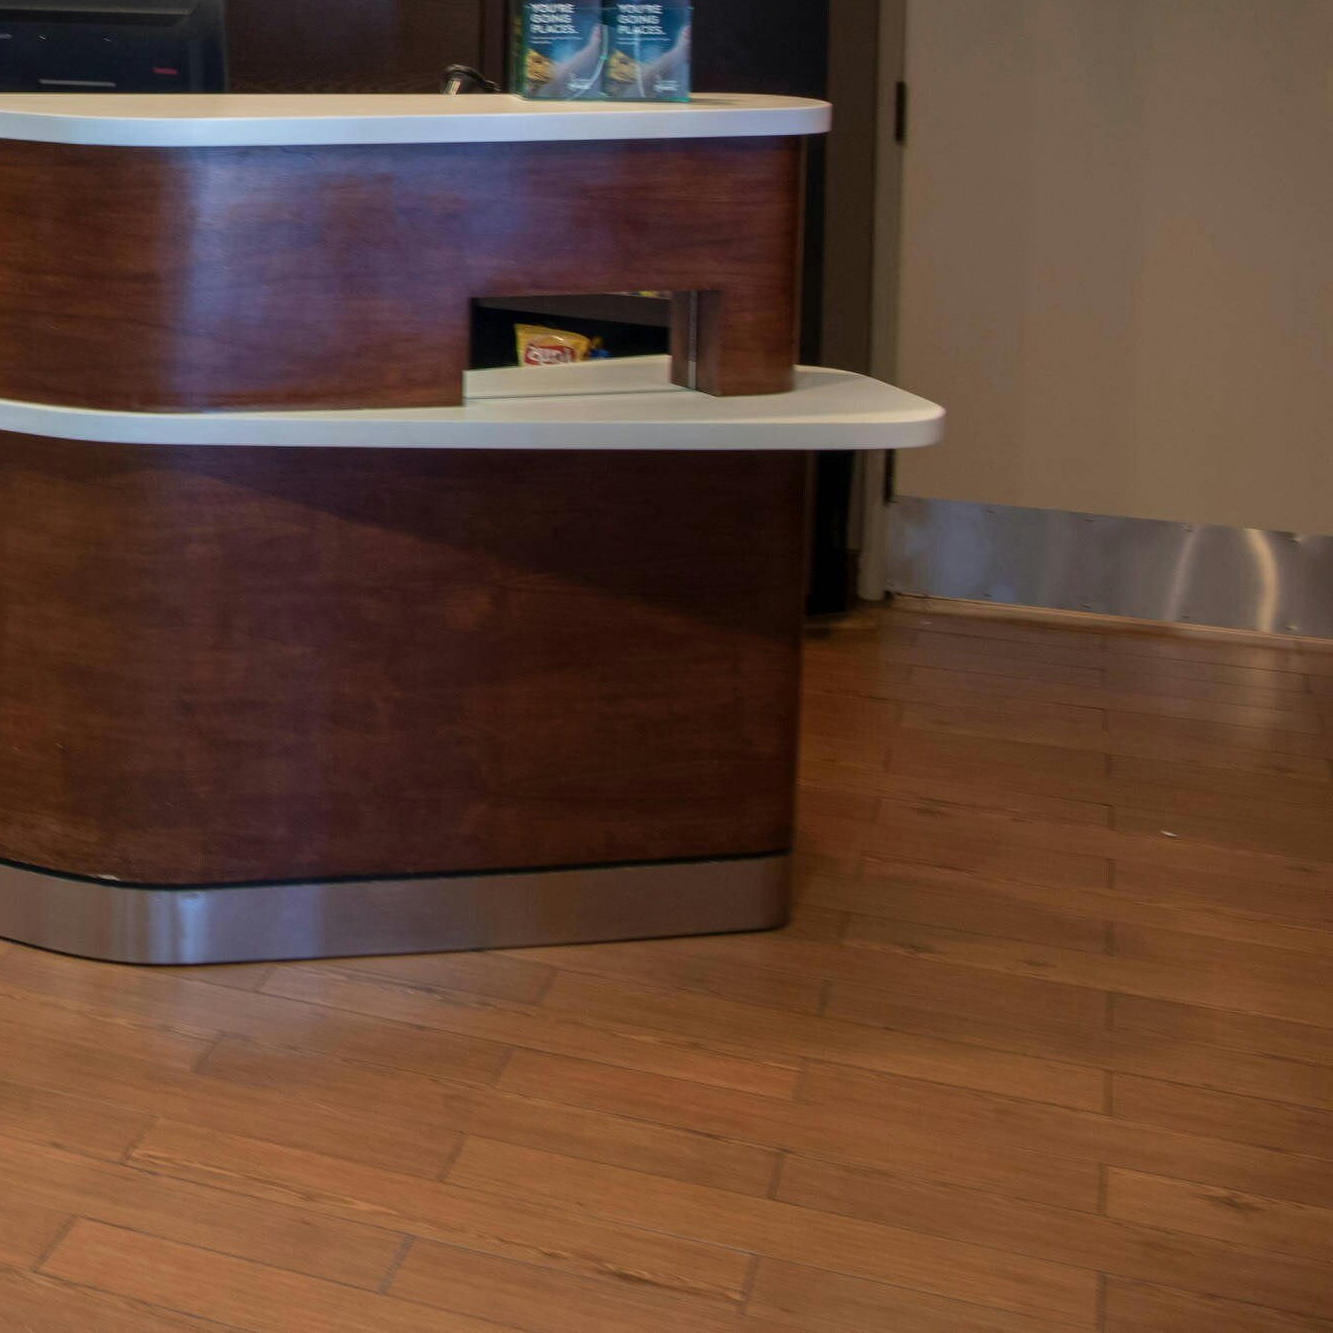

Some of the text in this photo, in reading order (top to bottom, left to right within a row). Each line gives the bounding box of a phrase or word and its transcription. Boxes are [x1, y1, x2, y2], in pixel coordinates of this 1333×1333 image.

[529, 3, 576, 14] YOU'RE
[616, 3, 664, 15] YOU'RE
[529, 14, 573, 24] GOING
[616, 14, 660, 25] GOING
